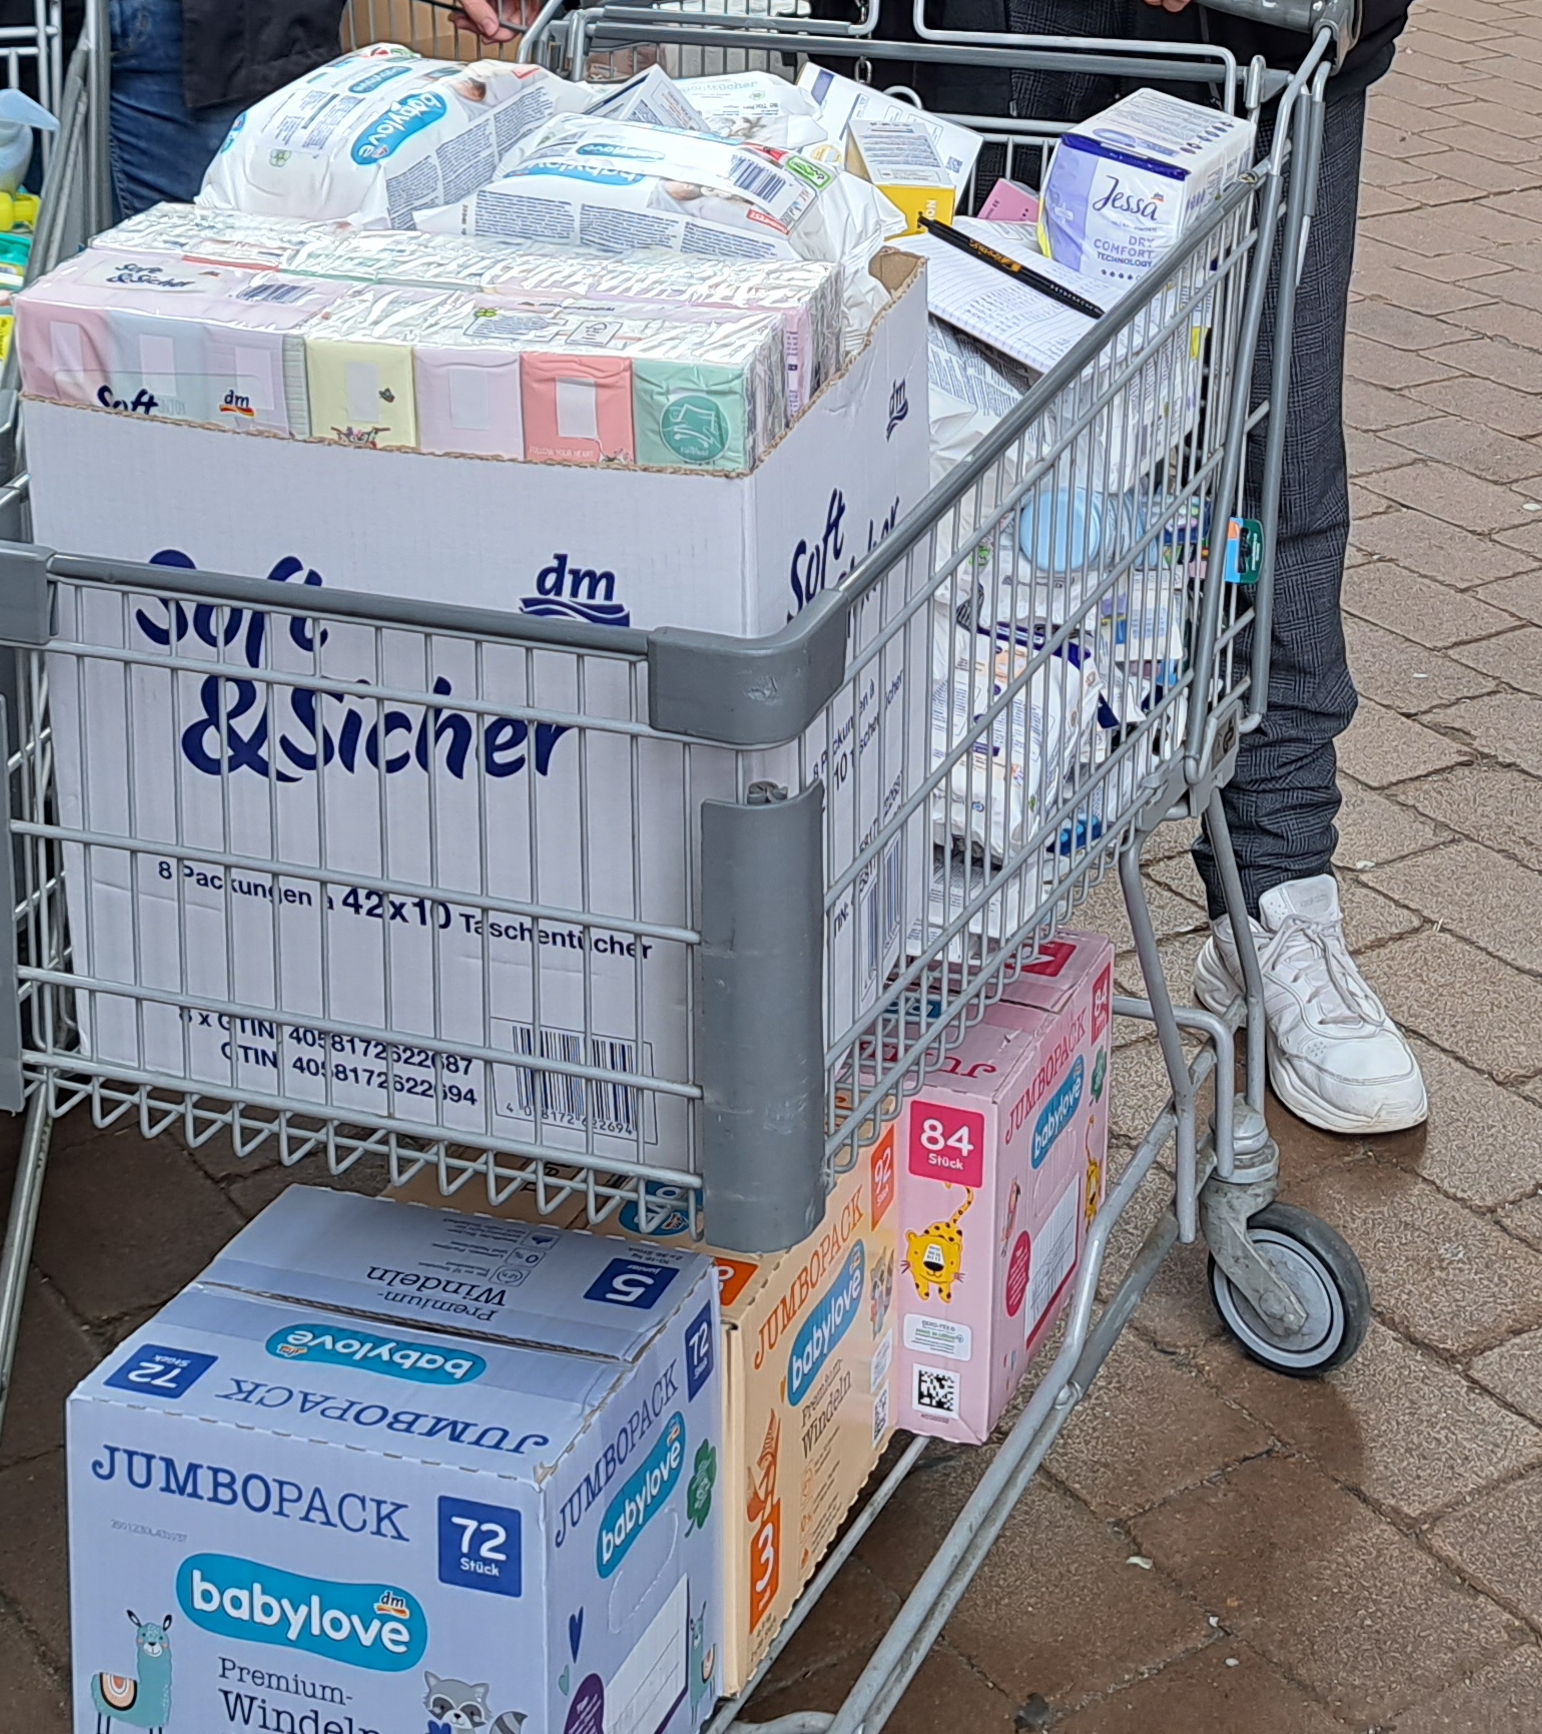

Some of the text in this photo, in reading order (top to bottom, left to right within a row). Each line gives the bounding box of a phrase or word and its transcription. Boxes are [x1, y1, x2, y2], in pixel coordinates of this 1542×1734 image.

[358, 93, 442, 157] babylove
[1092, 175, 1157, 221] Jessa
[1093, 238, 1155, 259] COMFORT
[1097, 252, 1152, 267] TECHNOLOGY
[1129, 235, 1156, 248] DRY
[224, 390, 249, 408] dm
[536, 553, 616, 602] dm
[180, 674, 578, 784] &Sicher
[158, 861, 173, 880] 8
[341, 886, 453, 930] 42x10
[459, 913, 653, 960] Taschentücher
[1005, 1007, 1088, 1146] JUMBOPACK
[920, 1117, 974, 1157] 84
[1033, 1078, 1083, 1156] babylove
[873, 1147, 892, 1186] 92
[928, 1154, 964, 1171] Stück
[366, 1265, 506, 1307] Windeln
[610, 1272, 651, 1296] 5
[755, 1185, 863, 1370] JUMBOPACK
[378, 1290, 498, 1323] Premium-
[791, 1268, 862, 1392] babylove
[154, 1353, 192, 1366] Stück
[288, 1329, 474, 1380] babylove
[689, 1322, 709, 1368] 72
[126, 1360, 181, 1389] 72
[215, 1377, 549, 1456] JUMBOPACK
[801, 1370, 852, 1460] Windeln
[555, 1358, 678, 1549] JUMBOPACK
[91, 1444, 411, 1543] JUMBOPACK
[601, 1440, 682, 1565] babylove
[451, 1516, 508, 1560] 72
[756, 1523, 775, 1592] 3
[460, 1557, 500, 1577] Stück
[190, 1569, 412, 1654] babylove
[380, 1592, 406, 1610] dm
[218, 1657, 353, 1706] Premium-
